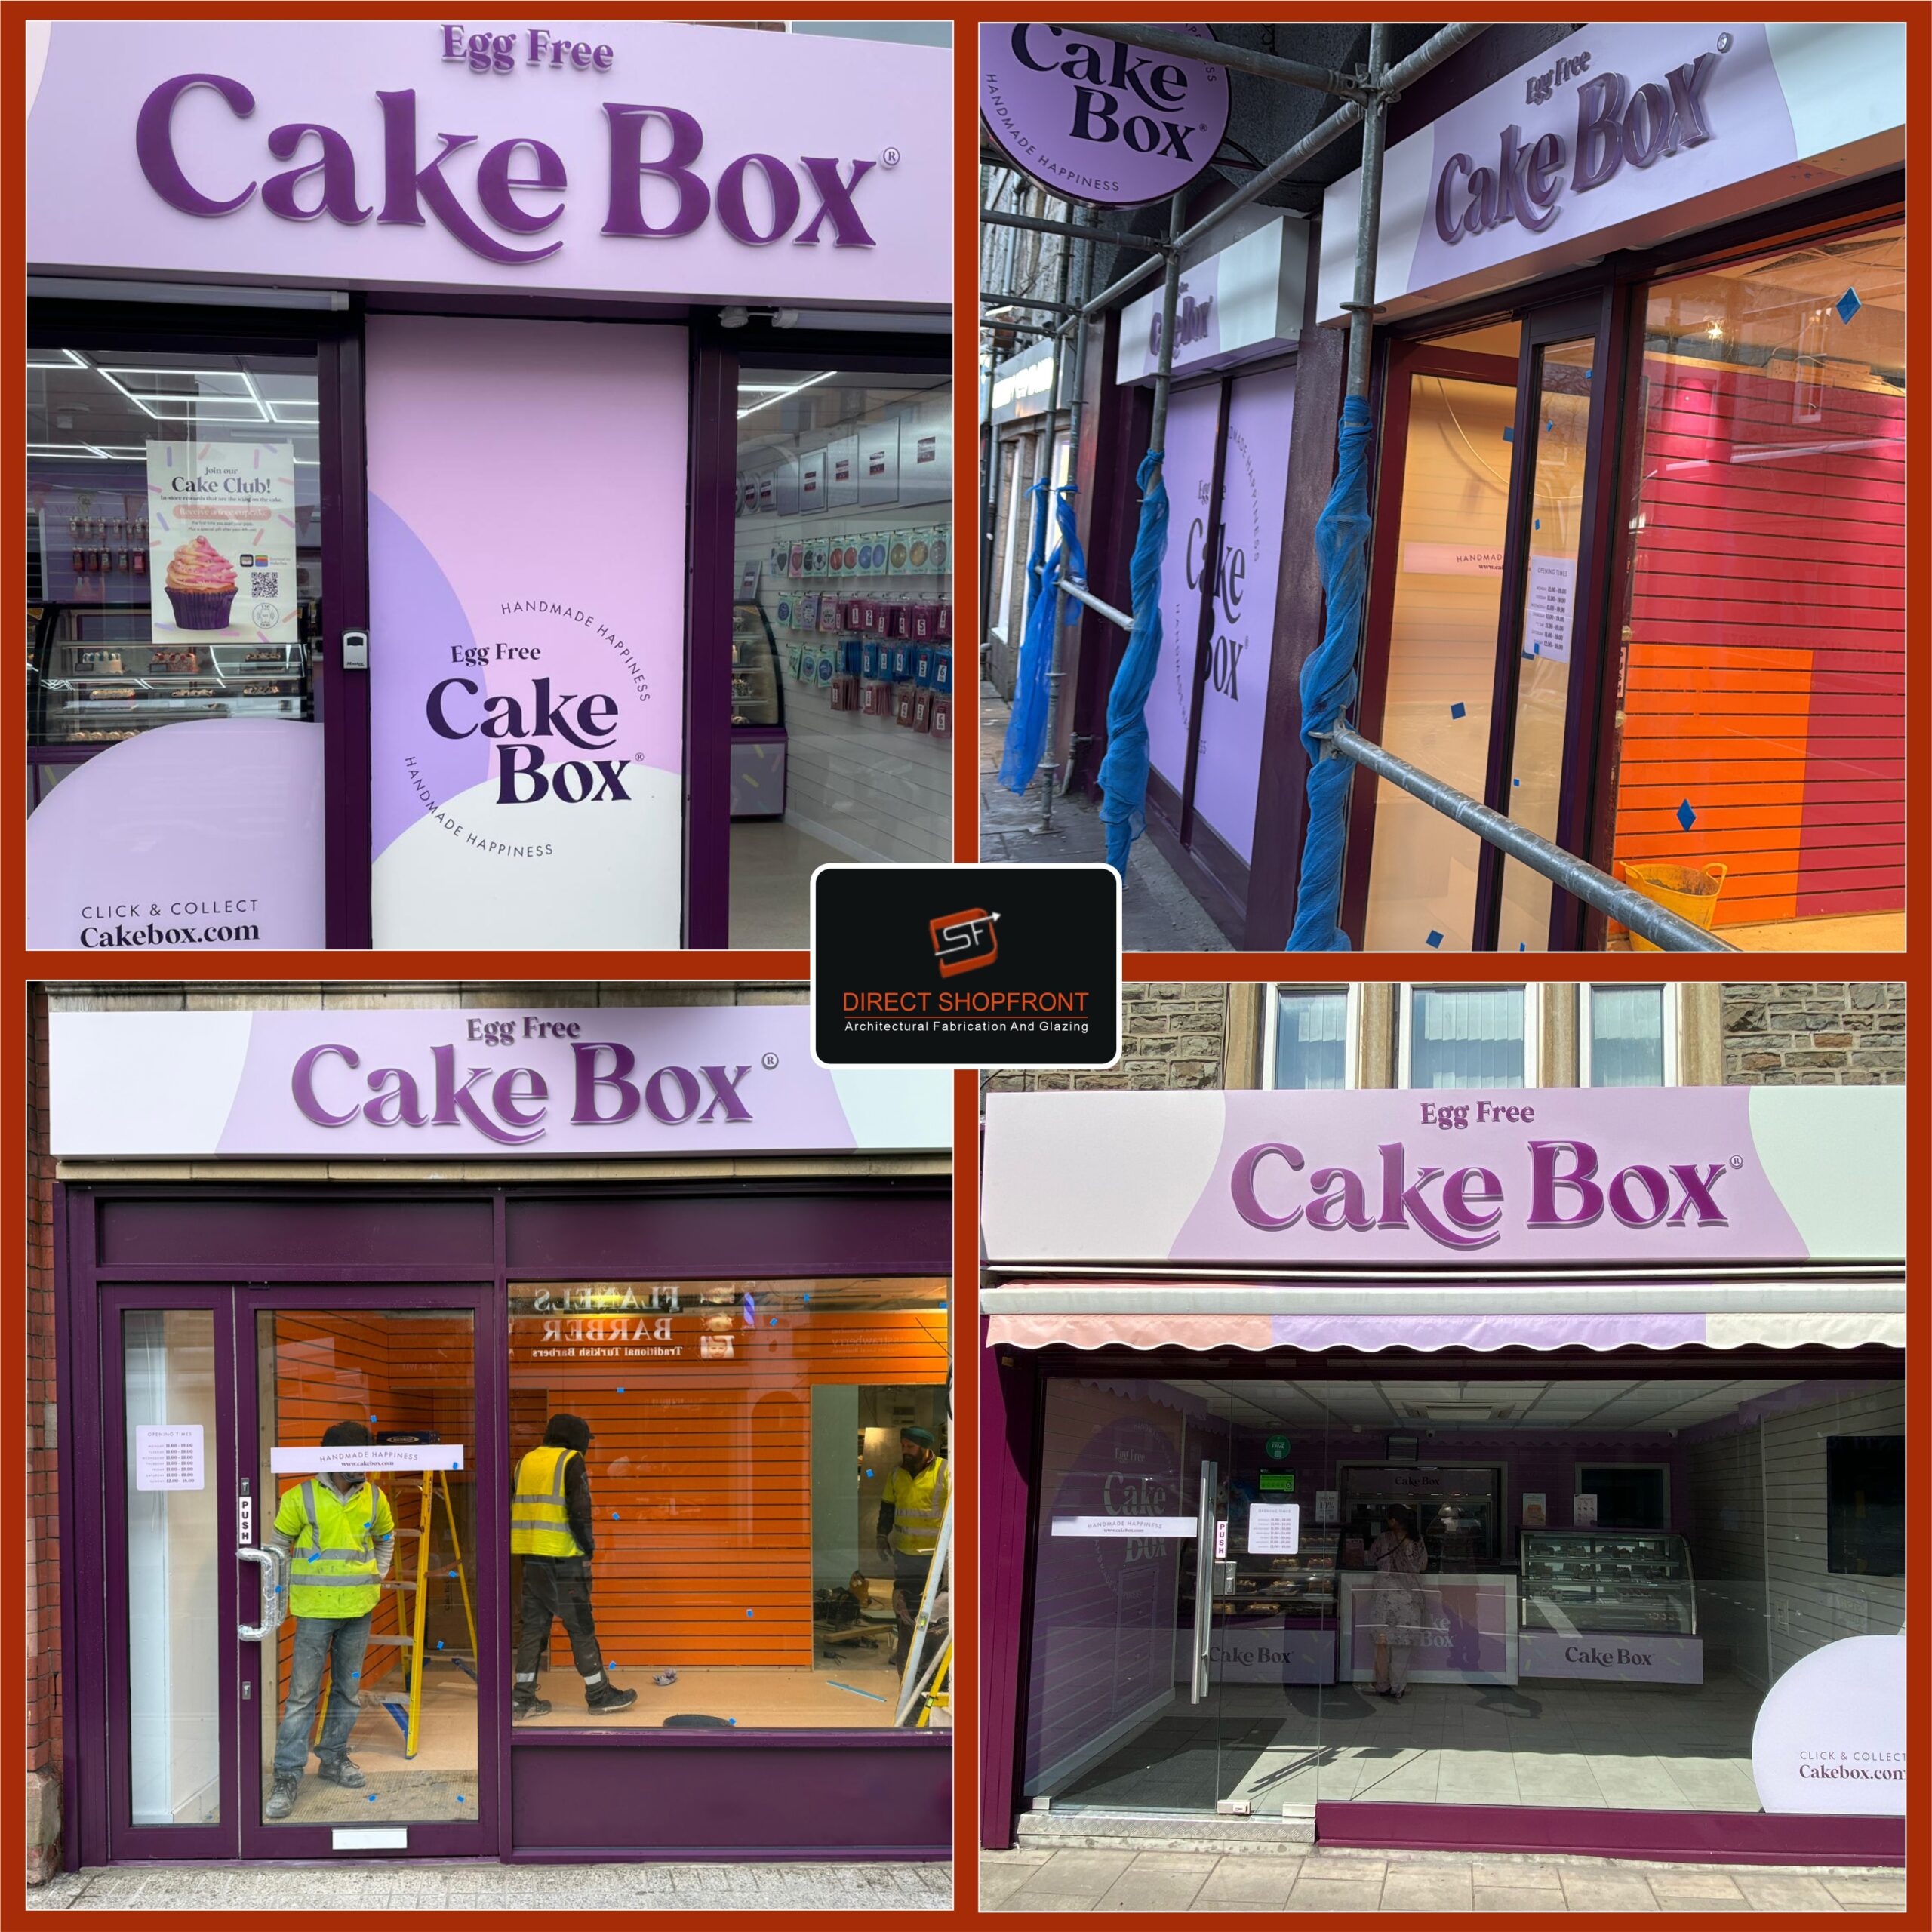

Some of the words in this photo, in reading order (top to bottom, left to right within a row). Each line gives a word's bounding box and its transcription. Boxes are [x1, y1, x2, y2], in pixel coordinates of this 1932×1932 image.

[441, 25, 517, 72] Egg
[527, 29, 614, 72] Free
[1011, 23, 1189, 112] Cake
[1525, 69, 1555, 106] Egg
[1555, 51, 1592, 83] Free
[986, 73, 1036, 156] HANDMADE
[1038, 155, 1121, 192] HAPPINESS
[136, 72, 568, 264] Cake
[1435, 125, 1567, 245] Cake
[171, 476, 219, 493] Cake
[223, 478, 271, 494] Club!
[205, 467, 222, 475] Join
[1457, 553, 1503, 563] HANDMAD
[1537, 567, 1555, 575] OPENING
[1555, 569, 1567, 577] TIMES
[451, 645, 490, 668] Egg
[495, 644, 541, 660] Free
[501, 600, 594, 627] HANDMADE
[597, 624, 651, 702] HAPPINESS
[426, 677, 619, 750] Cake
[405, 756, 464, 837] HANDMADE
[466, 832, 554, 857] HAPPINESS
[82, 904, 140, 919] CLICK
[149, 903, 162, 917] &
[171, 900, 259, 915] COLLECT
[80, 923, 260, 949] Cakebox.com
[466, 1017, 515, 1046] Egg
[522, 1016, 581, 1040] Free
[291, 1043, 549, 1145] Cake
[1420, 1101, 1469, 1130] Egg
[1475, 1100, 1535, 1124] Free
[1230, 1141, 1505, 1251] Cake
[320, 1452, 368, 1463] HANDMADE
[372, 1451, 418, 1461] HAPPINESS
[1130, 1448, 1146, 1463] Free
[1103, 1471, 1166, 1517] Cake
[1395, 1476, 1420, 1487] Cake
[1088, 1521, 1124, 1529] HANDMADE
[1127, 1521, 1163, 1530] HAPPINESS
[1565, 1647, 1614, 1668] Cake
[1800, 1751, 1835, 1760] CLICK
[1841, 1752, 1847, 1761] &
